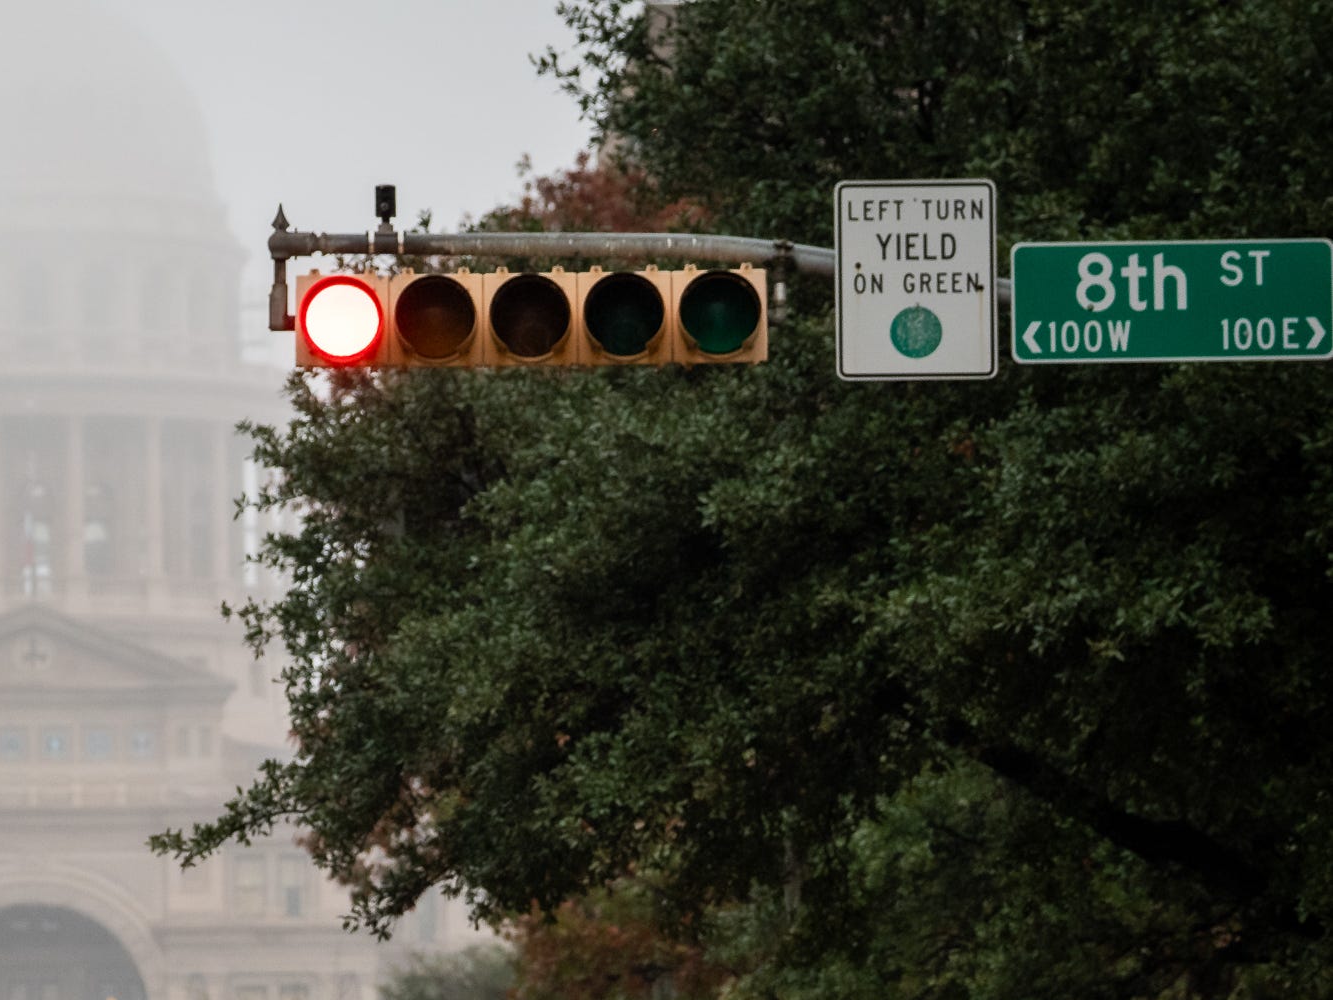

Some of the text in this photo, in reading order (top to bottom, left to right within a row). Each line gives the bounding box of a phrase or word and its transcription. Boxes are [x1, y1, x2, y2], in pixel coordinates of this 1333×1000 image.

[847, 198, 984, 221] LEFT TURN
[875, 232, 957, 261] YIELD
[853, 271, 981, 295] ON GREEN
[1075, 250, 1271, 312] 8th ST
[1048, 316, 1300, 353] 100W 100E
